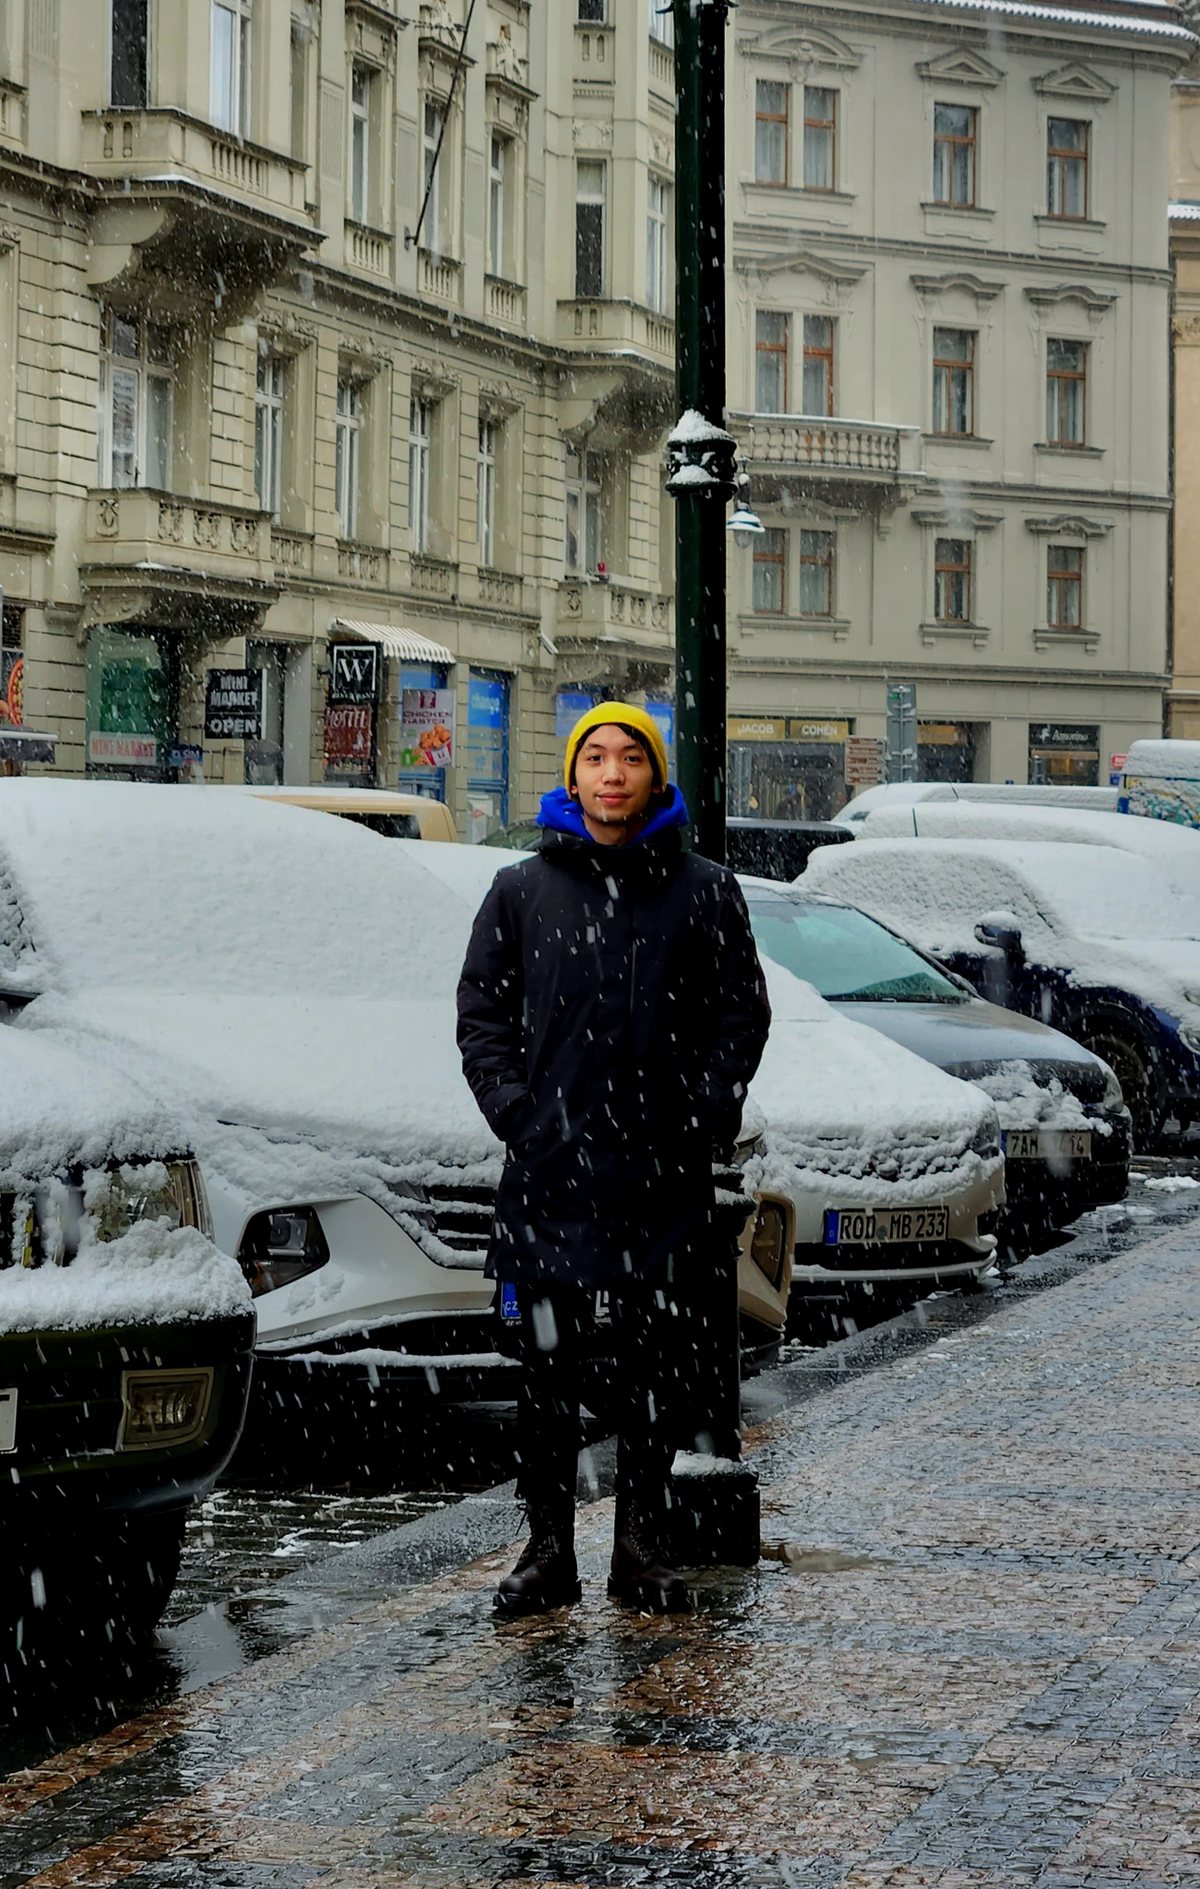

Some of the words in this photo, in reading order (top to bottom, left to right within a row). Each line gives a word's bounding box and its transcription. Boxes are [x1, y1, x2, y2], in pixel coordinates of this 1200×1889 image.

[337, 658, 370, 683] W
[220, 675, 248, 690] MINI
[210, 691, 258, 706] MARKET
[326, 707, 366, 728] HOSTEL
[210, 719, 257, 733] OPEN
[738, 723, 775, 734] JACOB
[801, 725, 837, 735] COHEN
[840, 1214, 876, 1239] ROD
[889, 1213, 912, 1238] MB
[915, 1212, 946, 1238] 233
[505, 1300, 518, 1311] CZ
